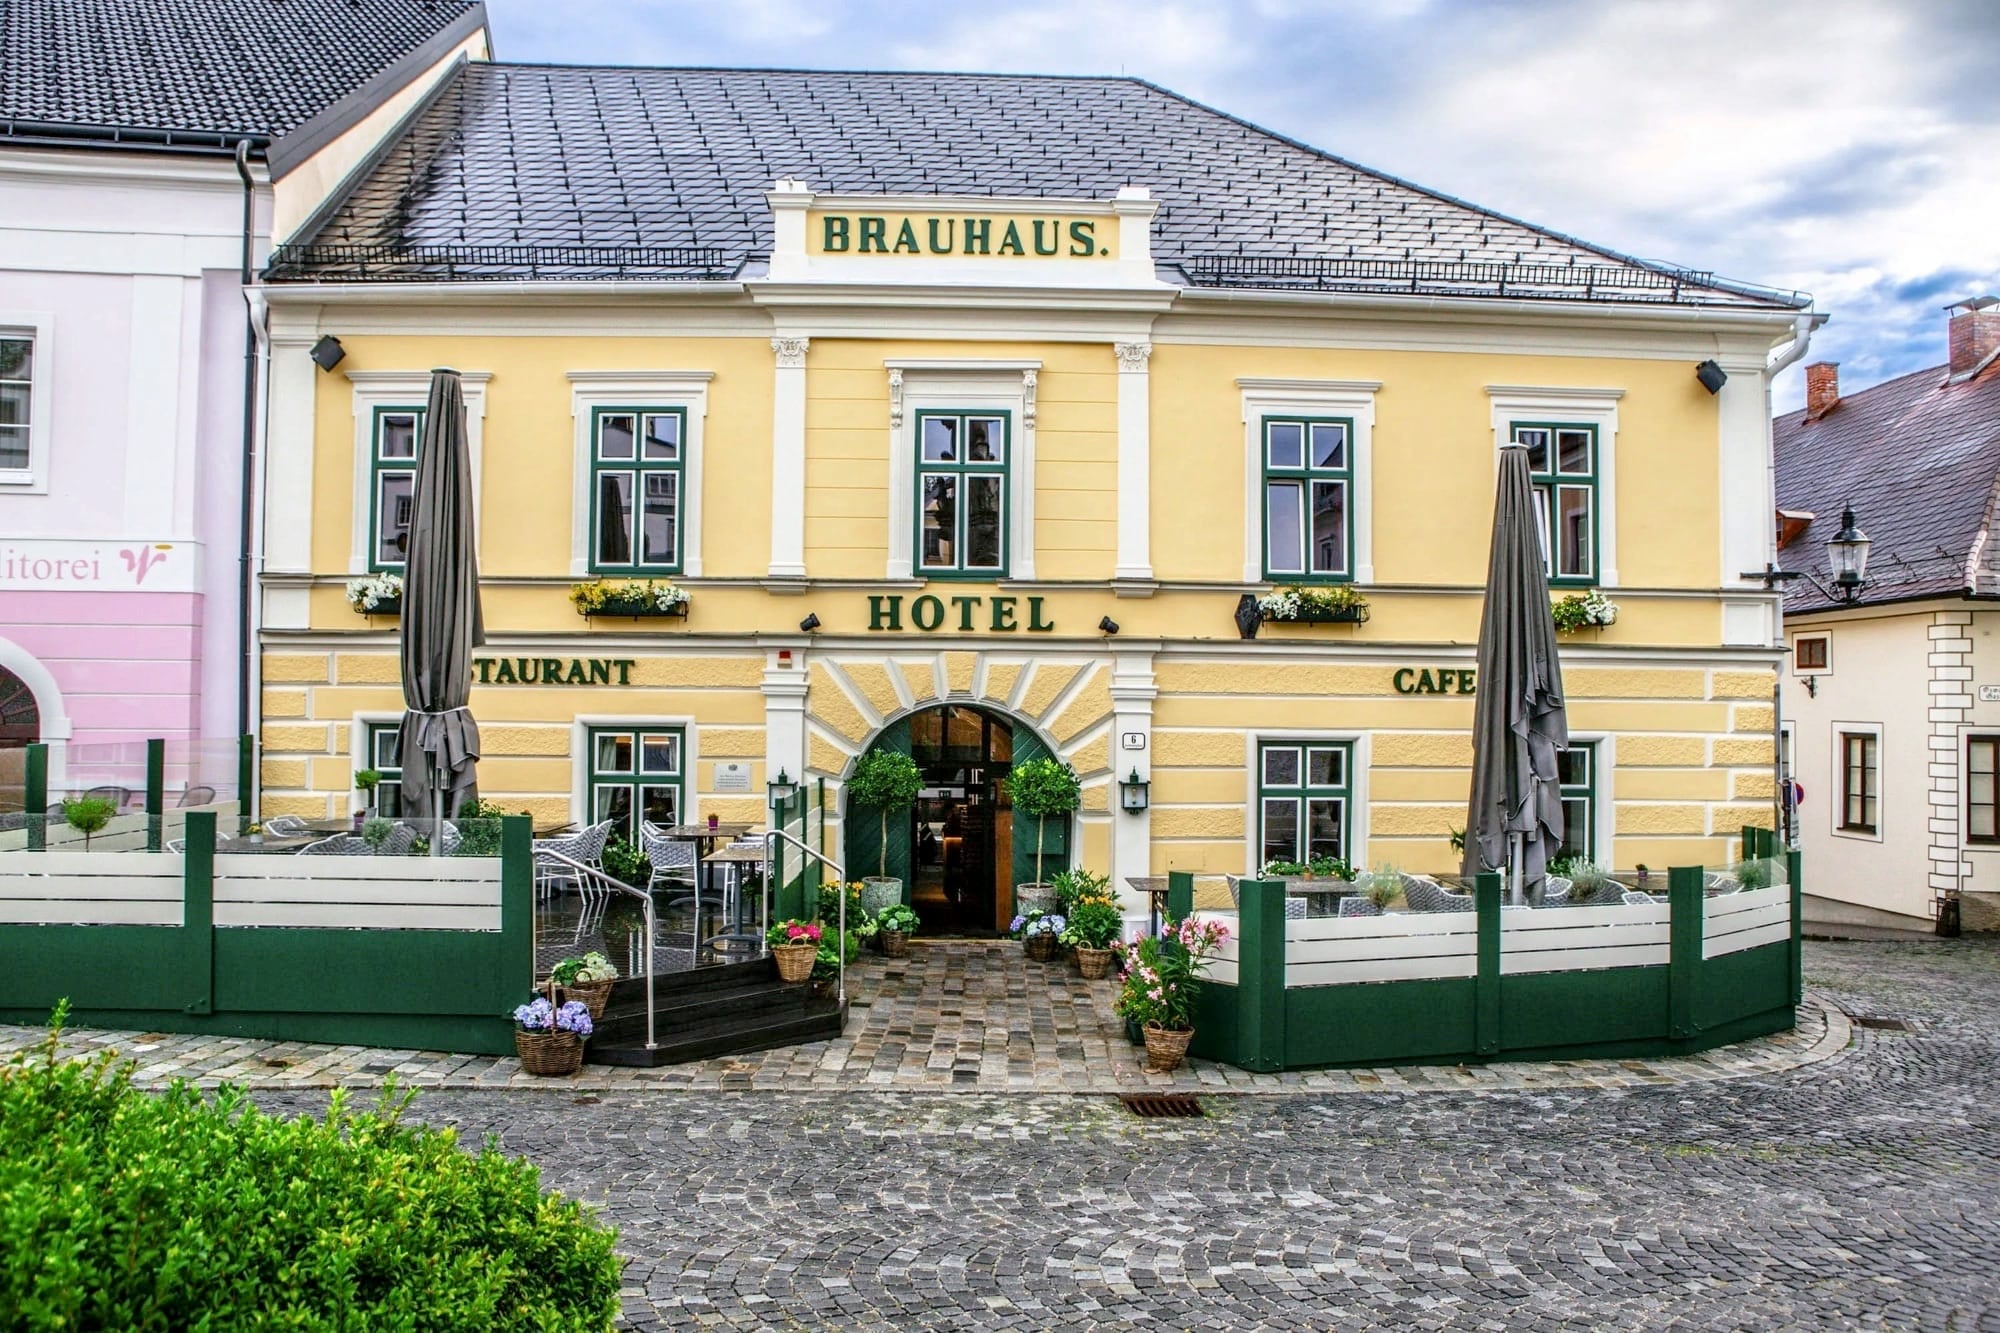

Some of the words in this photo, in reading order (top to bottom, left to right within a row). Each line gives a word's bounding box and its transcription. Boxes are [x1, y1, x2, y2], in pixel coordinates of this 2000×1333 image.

[823, 217, 1108, 257] BRAUHAUS.
[0, 549, 100, 580] itorei
[868, 595, 1054, 631] HOTEL
[471, 658, 635, 684] TAURANT
[1393, 668, 1476, 694] CAFE
[1131, 735, 1137, 744] 6
